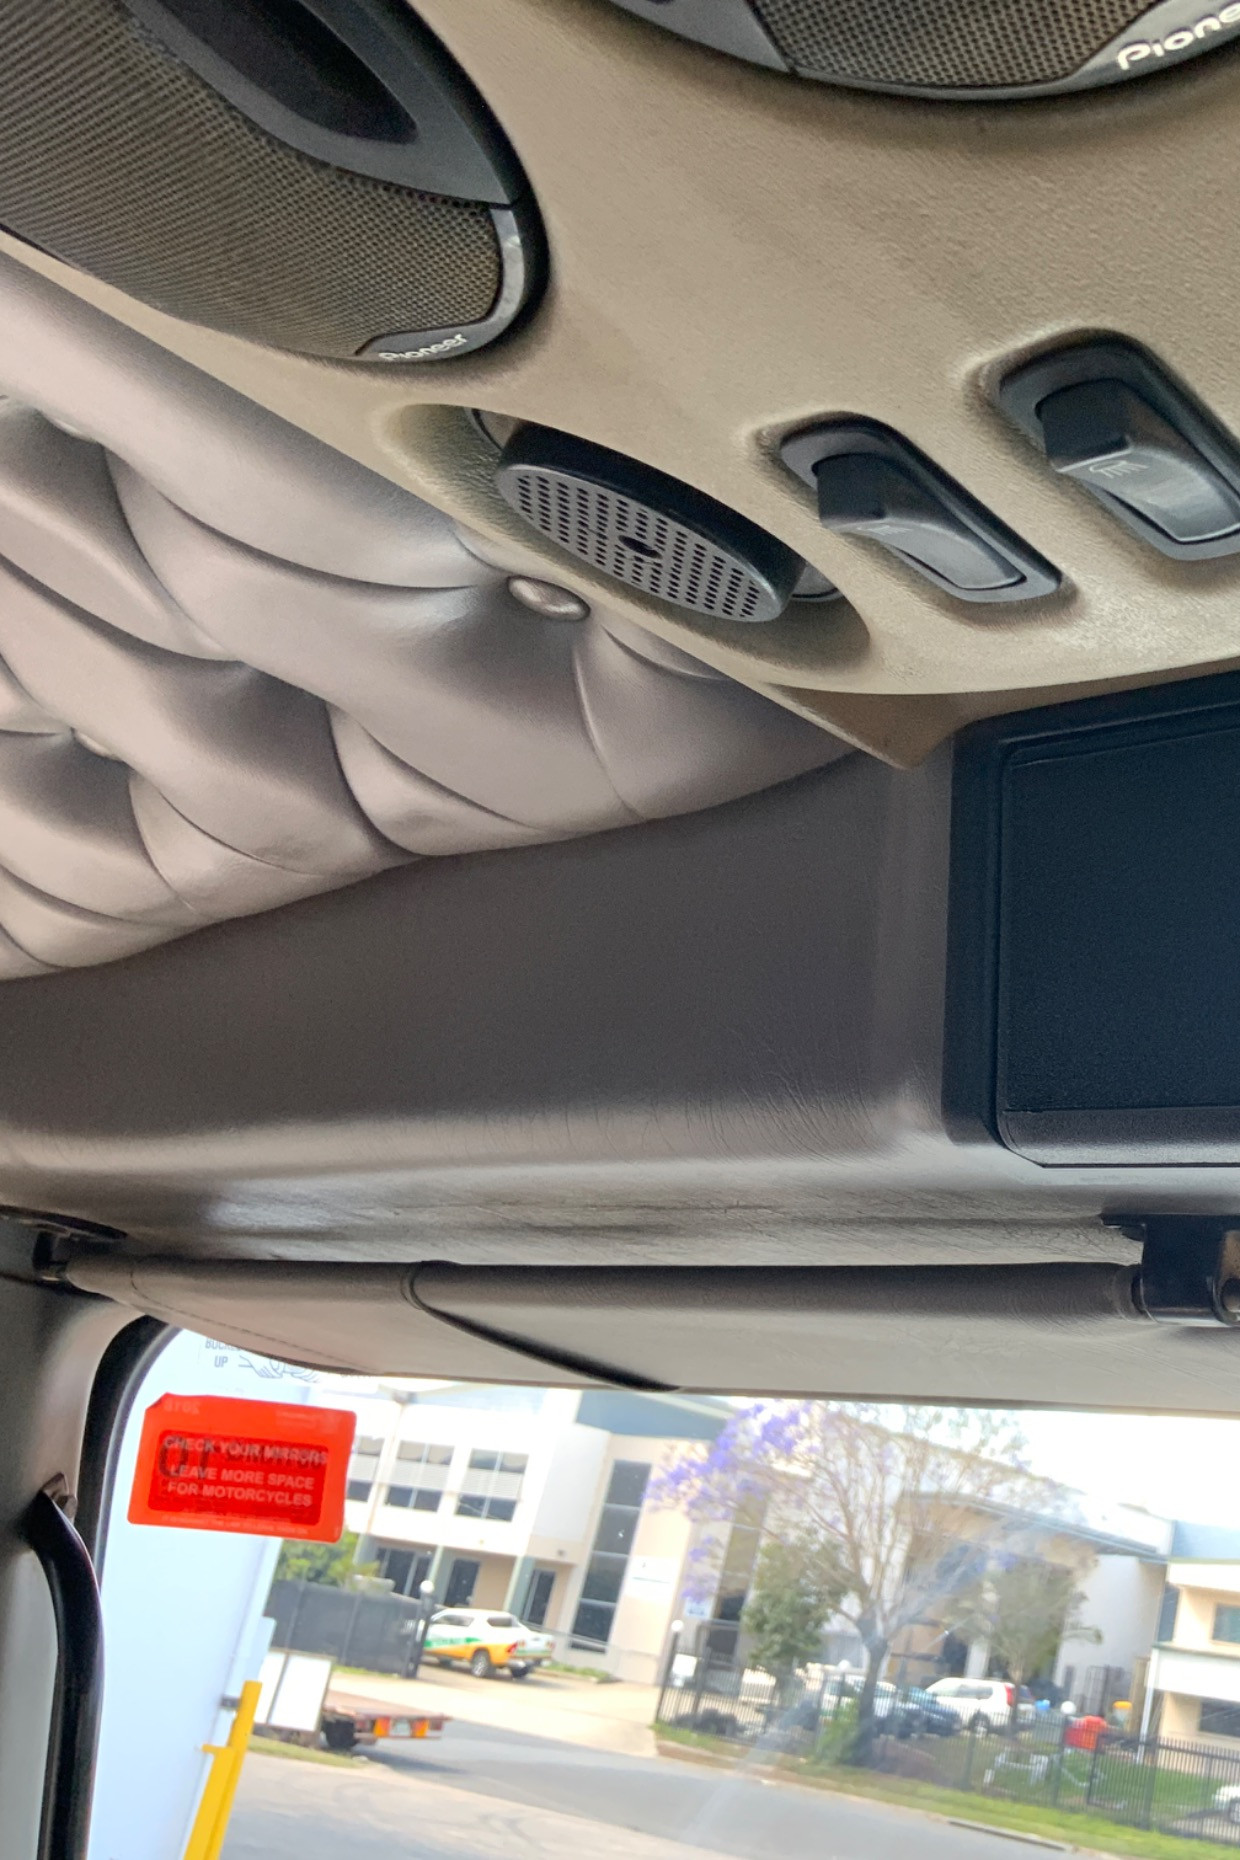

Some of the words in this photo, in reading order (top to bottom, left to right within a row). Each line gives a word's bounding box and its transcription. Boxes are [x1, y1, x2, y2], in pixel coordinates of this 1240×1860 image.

[379, 333, 467, 361] Pioneer
[214, 1355, 228, 1368] UP
[163, 1436, 215, 1452] CHECK
[219, 1441, 260, 1457] YOUR
[263, 1444, 329, 1464] MIRRORS
[170, 1464, 217, 1481] LEAVE
[221, 1468, 264, 1485] MORE
[267, 1473, 315, 1491] SPACE
[167, 1481, 199, 1496] FOR
[202, 1484, 313, 1507] MOTORCYCLES
